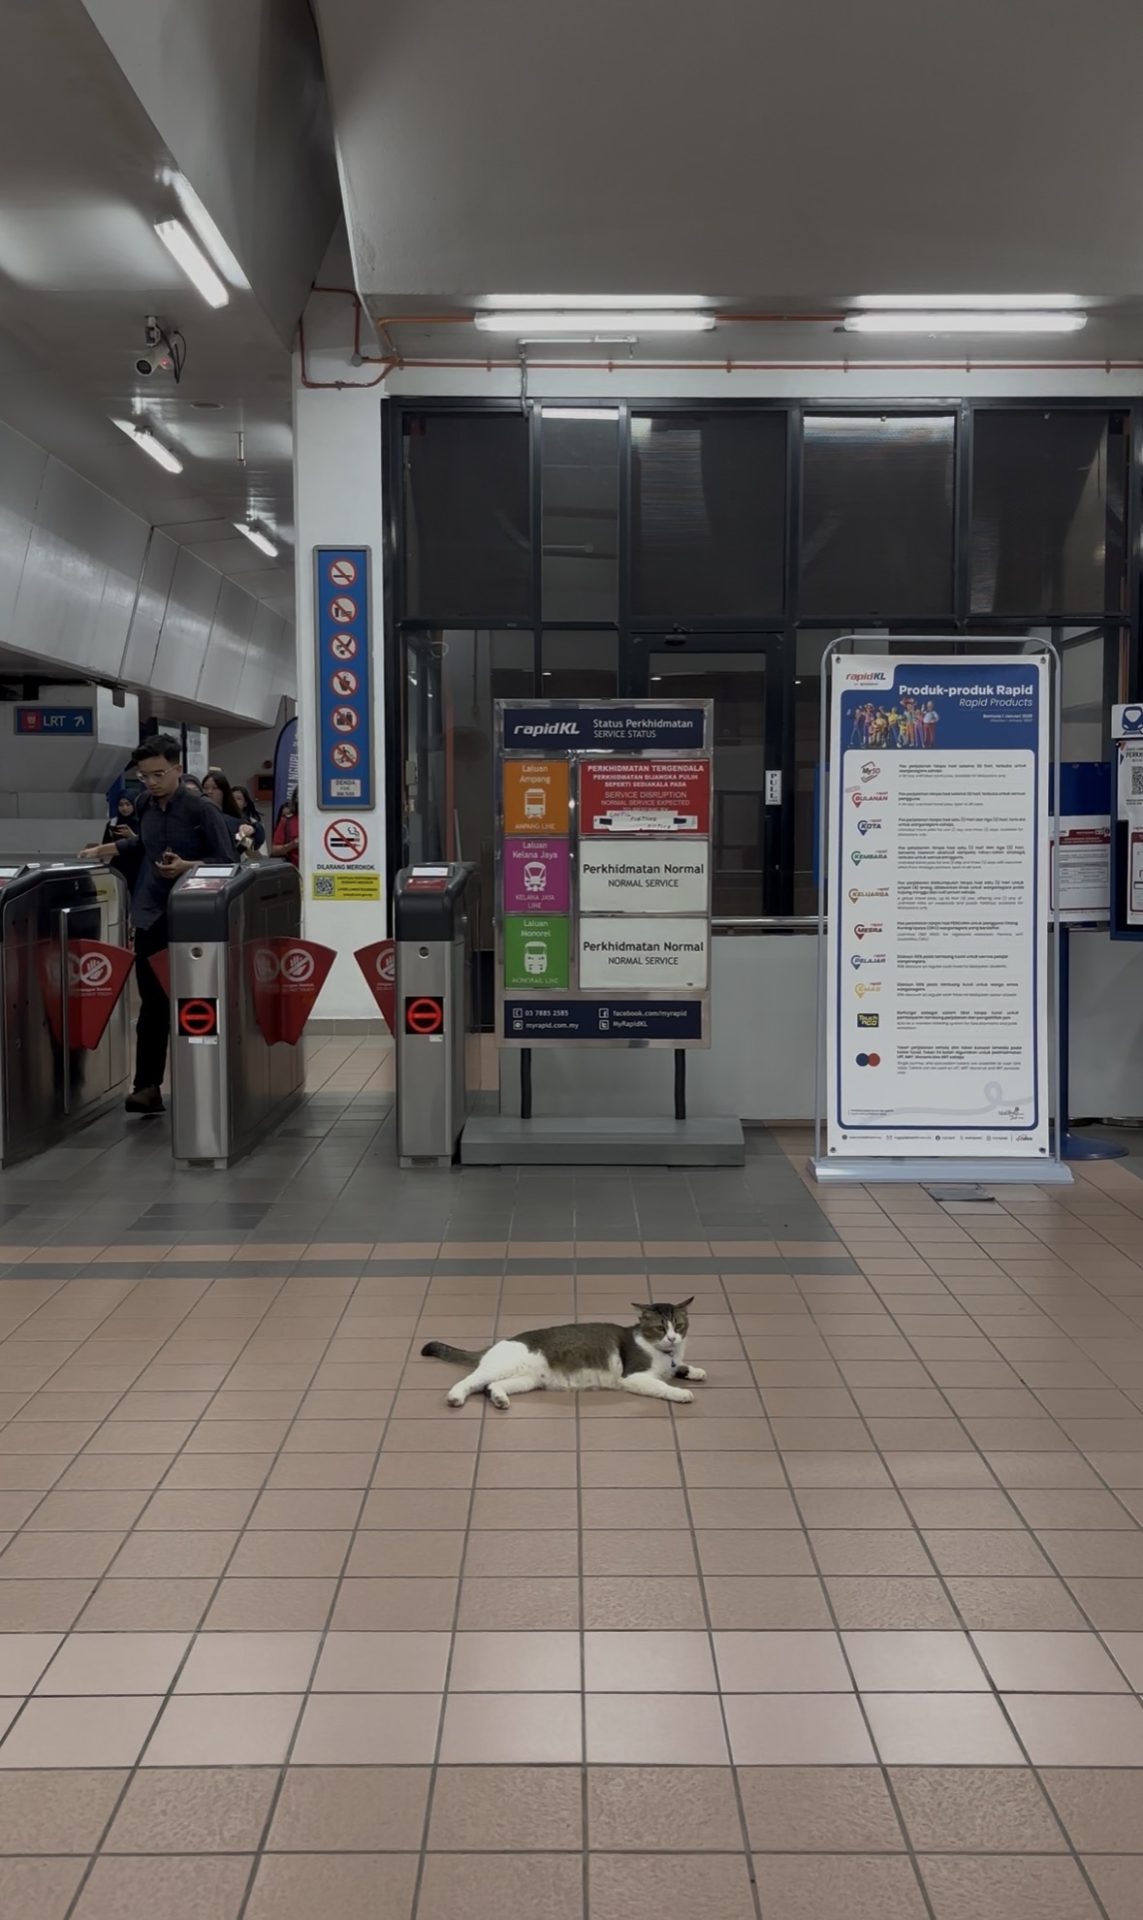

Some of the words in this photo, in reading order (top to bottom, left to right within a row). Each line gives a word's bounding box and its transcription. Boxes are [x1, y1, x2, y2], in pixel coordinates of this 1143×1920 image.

[846, 672, 886, 682] rapidKL
[898, 684, 994, 697] Produk-produk
[996, 684, 1034, 697] Rapid
[959, 698, 988, 708] Rapid
[990, 698, 1033, 707] Products
[43, 715, 66, 727] LRT
[593, 719, 623, 728] Status
[626, 719, 693, 728] Perkhidmatan
[514, 722, 580, 736] rapidKL
[522, 765, 548, 773] Laluan
[519, 775, 551, 785] Ampang
[540, 851, 558, 860] Jaya
[583, 864, 660, 874] Perkhidmatan
[664, 864, 704, 874] Normal
[583, 942, 660, 951] Perkhidmatan
[664, 942, 704, 951] Normal
